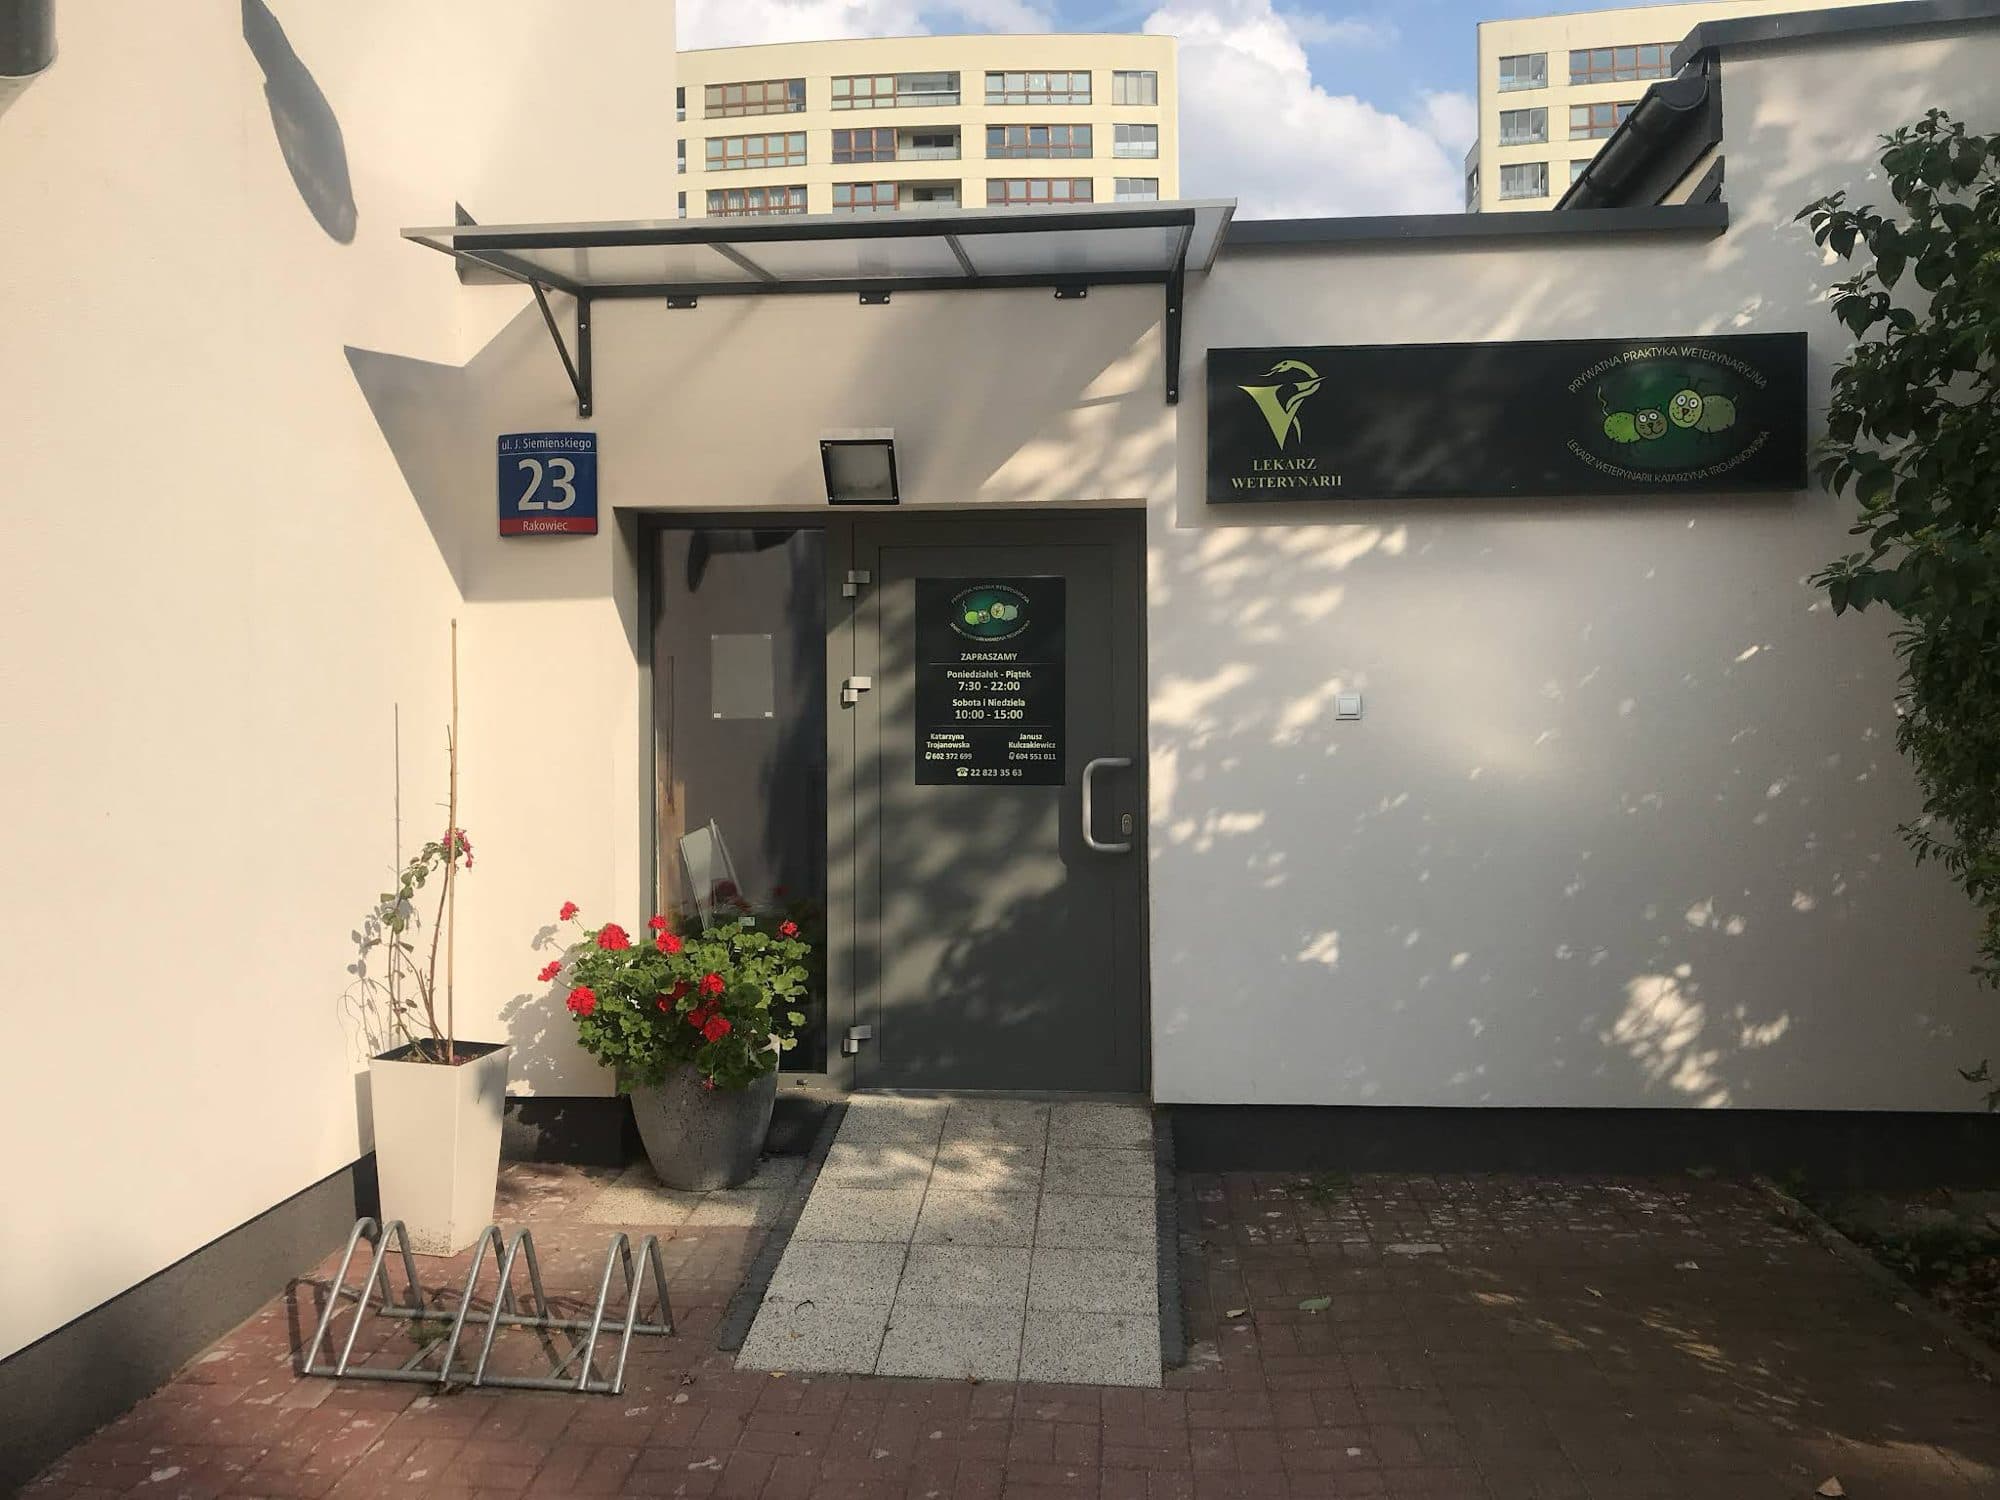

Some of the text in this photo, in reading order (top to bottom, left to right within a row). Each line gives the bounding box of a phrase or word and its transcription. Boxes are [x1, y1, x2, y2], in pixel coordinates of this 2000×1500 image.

[1568, 346, 1767, 393] PRYWATNA PRAKTYKA WETERYNARYJNA
[501, 439, 513, 450] ul.
[514, 439, 521, 450] J.
[1567, 438, 1596, 465] LEKARZ
[1253, 458, 1317, 471] LEKARZ
[518, 457, 576, 511] 23
[1231, 475, 1342, 488] WETERYNARII
[523, 520, 569, 531] Rakowiec
[960, 652, 1018, 661] ZAPRASZAMY
[1005, 670, 1032, 680] Piątek
[958, 681, 981, 691] 7:30
[990, 681, 1020, 691] 22:00
[952, 698, 981, 707] Sobota
[987, 698, 1026, 707] Niedziela
[955, 710, 985, 720] 10:00
[993, 710, 1024, 720] 15:00
[930, 733, 965, 741] Katarzyna
[925, 741, 971, 750] Trojanowska
[932, 752, 945, 760] 602
[945, 752, 959, 760] 372
[1015, 752, 1029, 760] 604
[970, 768, 1022, 777] 22 823 35 63
